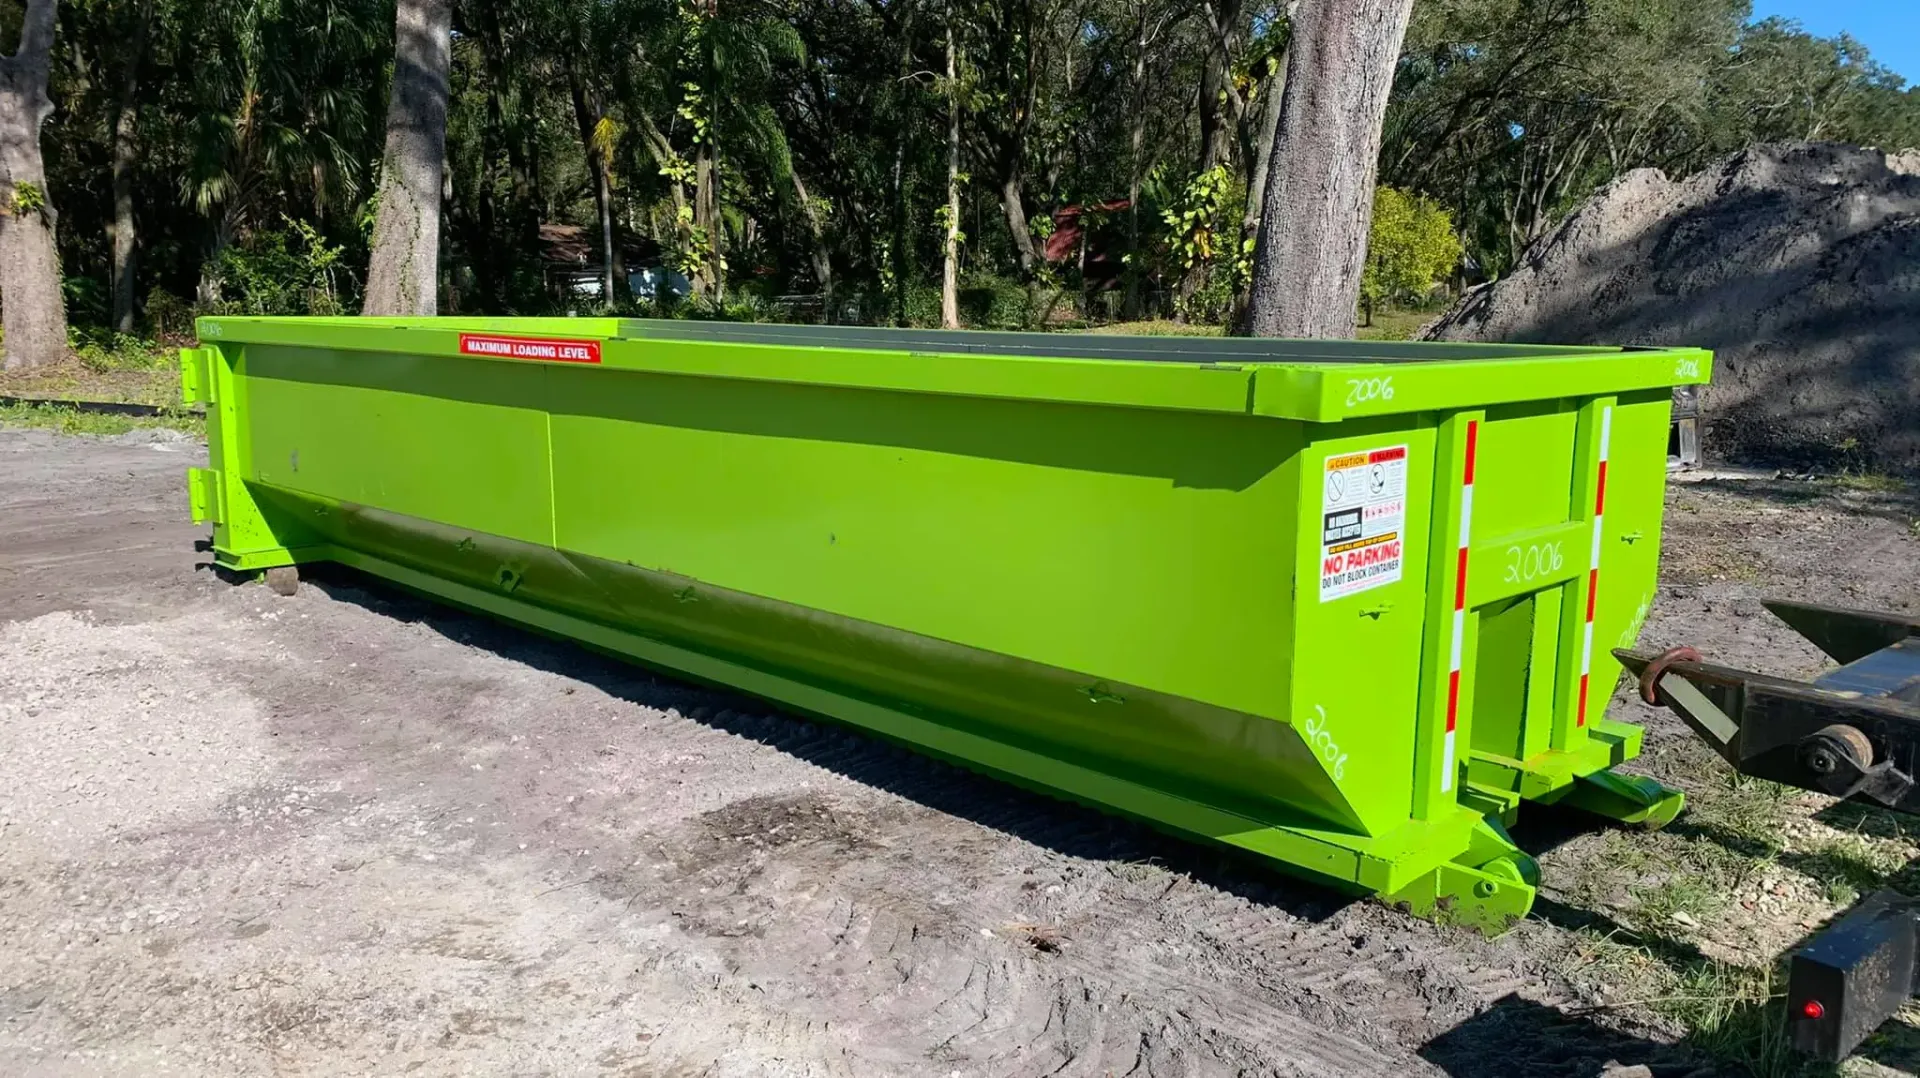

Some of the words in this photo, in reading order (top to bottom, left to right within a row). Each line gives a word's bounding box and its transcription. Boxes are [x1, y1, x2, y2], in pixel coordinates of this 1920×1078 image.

[467, 340, 511, 354] MAXIMUM
[513, 344, 556, 358] LOADING
[558, 346, 591, 360] LEVEL
[1675, 358, 1699, 379] 2006
[1345, 376, 1395, 407] 2006
[1335, 456, 1365, 468] CAUTION
[1323, 555, 1343, 576] NO
[1346, 541, 1401, 570] PARKING
[1503, 540, 1564, 583] 2006
[1322, 577, 1332, 589] DO
[1333, 573, 1346, 586] NOT
[1347, 569, 1367, 583] BLOCK
[1368, 559, 1400, 577] CONTAINER
[1305, 704, 1348, 781] 2006
